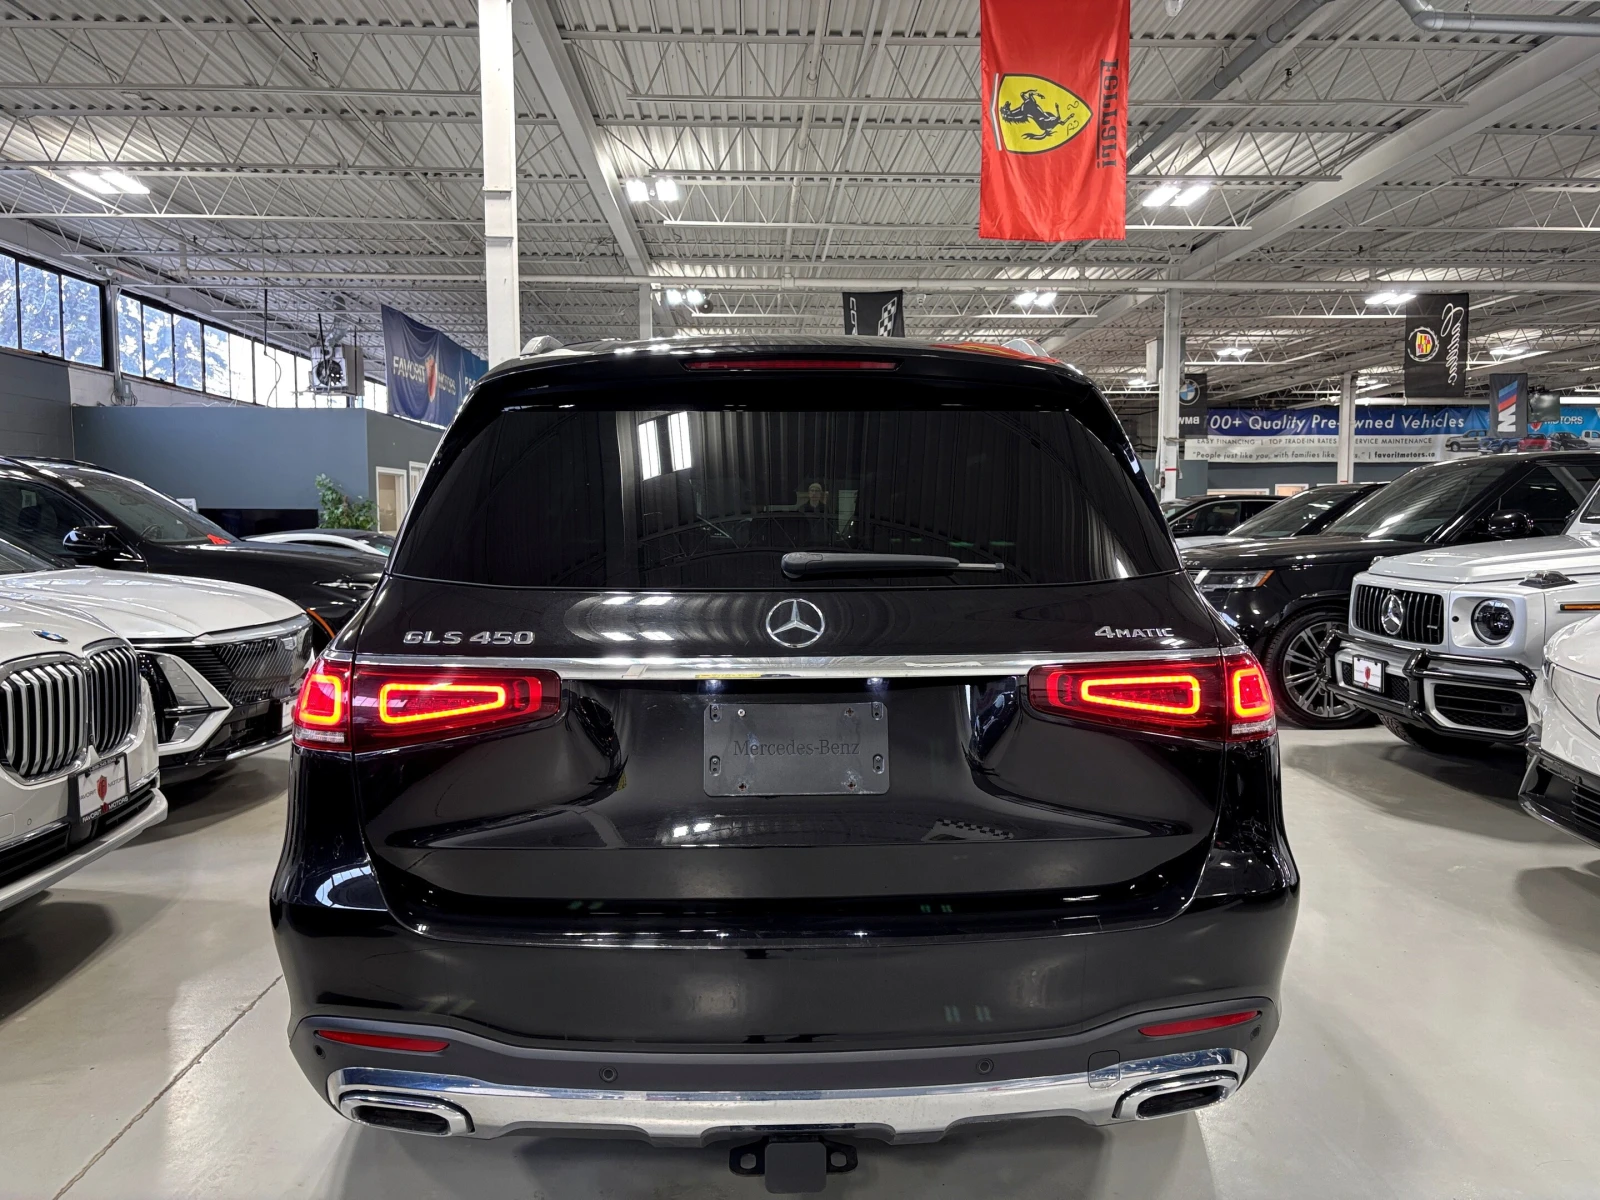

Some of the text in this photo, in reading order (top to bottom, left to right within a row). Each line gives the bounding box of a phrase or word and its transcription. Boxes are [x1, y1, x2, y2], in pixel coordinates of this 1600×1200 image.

[393, 356, 426, 383] FAVORIT
[1249, 414, 1306, 432] Quality
[1311, 413, 1395, 429] Pre-wned
[1401, 412, 1465, 429] Vehicles
[1544, 416, 1584, 425] TORS
[1381, 437, 1432, 445] MAINTENANCE
[1223, 451, 1238, 459] just
[1239, 451, 1253, 459] like
[403, 630, 536, 645] GLS 450
[1094, 625, 1175, 639] 4MATIC
[733, 739, 861, 756] Mercedes-Benz
[80, 788, 97, 800] AVORIT
[82, 796, 129, 823] FAVORIT MOTORS
